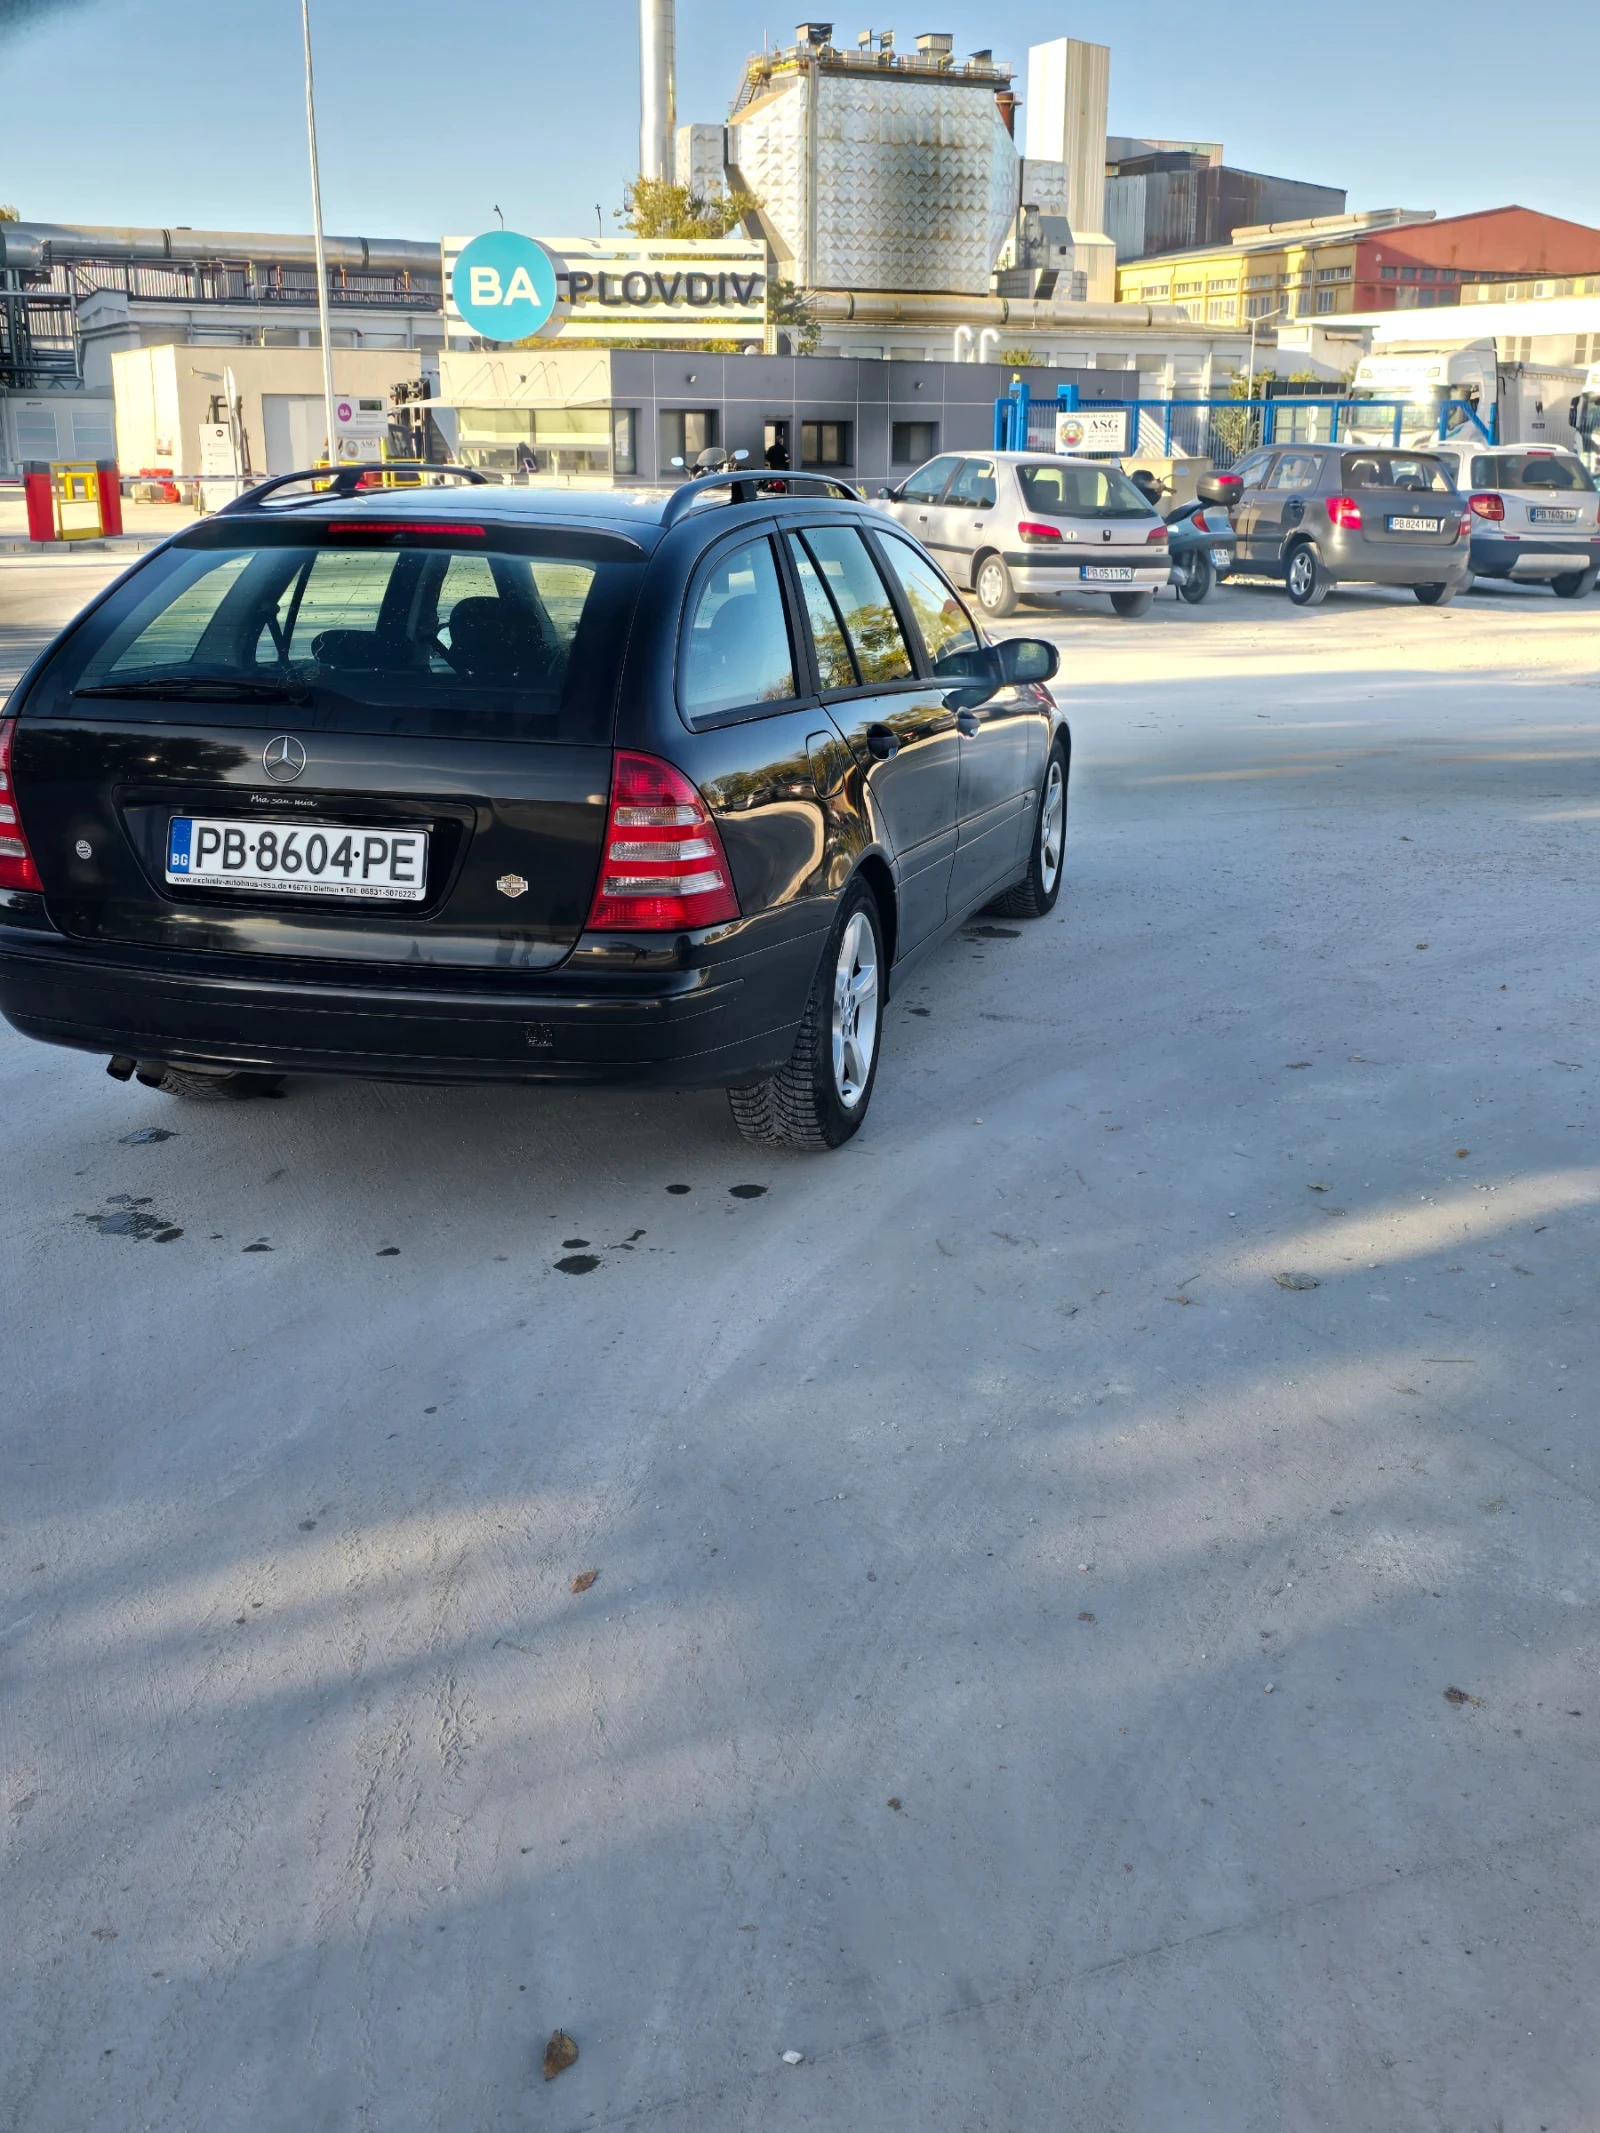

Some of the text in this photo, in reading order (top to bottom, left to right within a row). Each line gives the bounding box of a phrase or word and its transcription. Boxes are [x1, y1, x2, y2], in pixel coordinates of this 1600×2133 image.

[470, 266, 766, 307] BA PLOVDIV
[1089, 420, 1118, 429] ASG
[171, 853, 188, 866] BG
